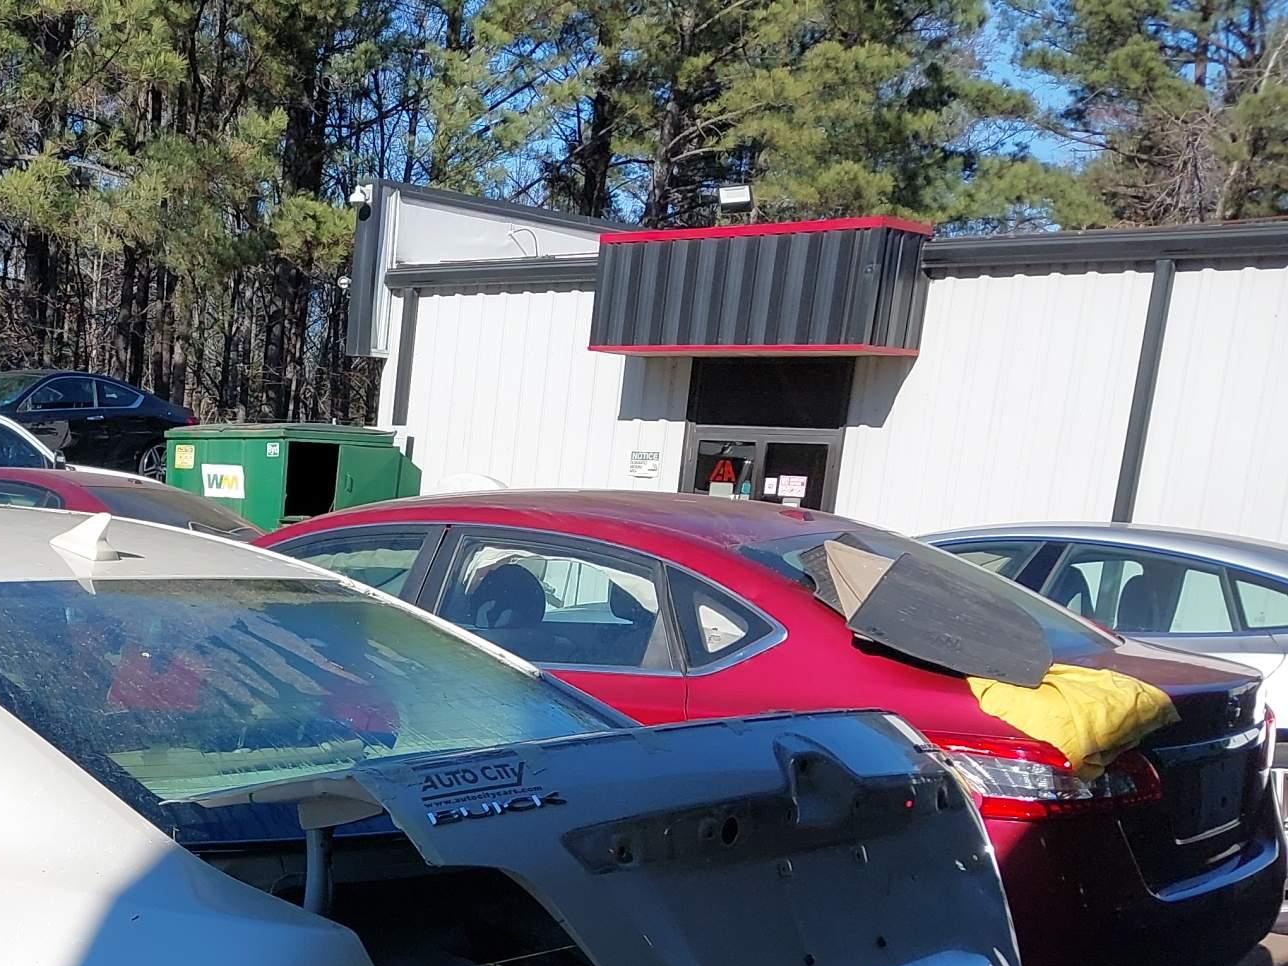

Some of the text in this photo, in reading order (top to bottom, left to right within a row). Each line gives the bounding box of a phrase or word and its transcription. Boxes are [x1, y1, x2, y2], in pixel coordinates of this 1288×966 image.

[632, 451, 660, 461] NOTICE
[206, 473, 240, 491] WM
[421, 769, 479, 792] AUTO
[426, 791, 568, 826] BUICK
